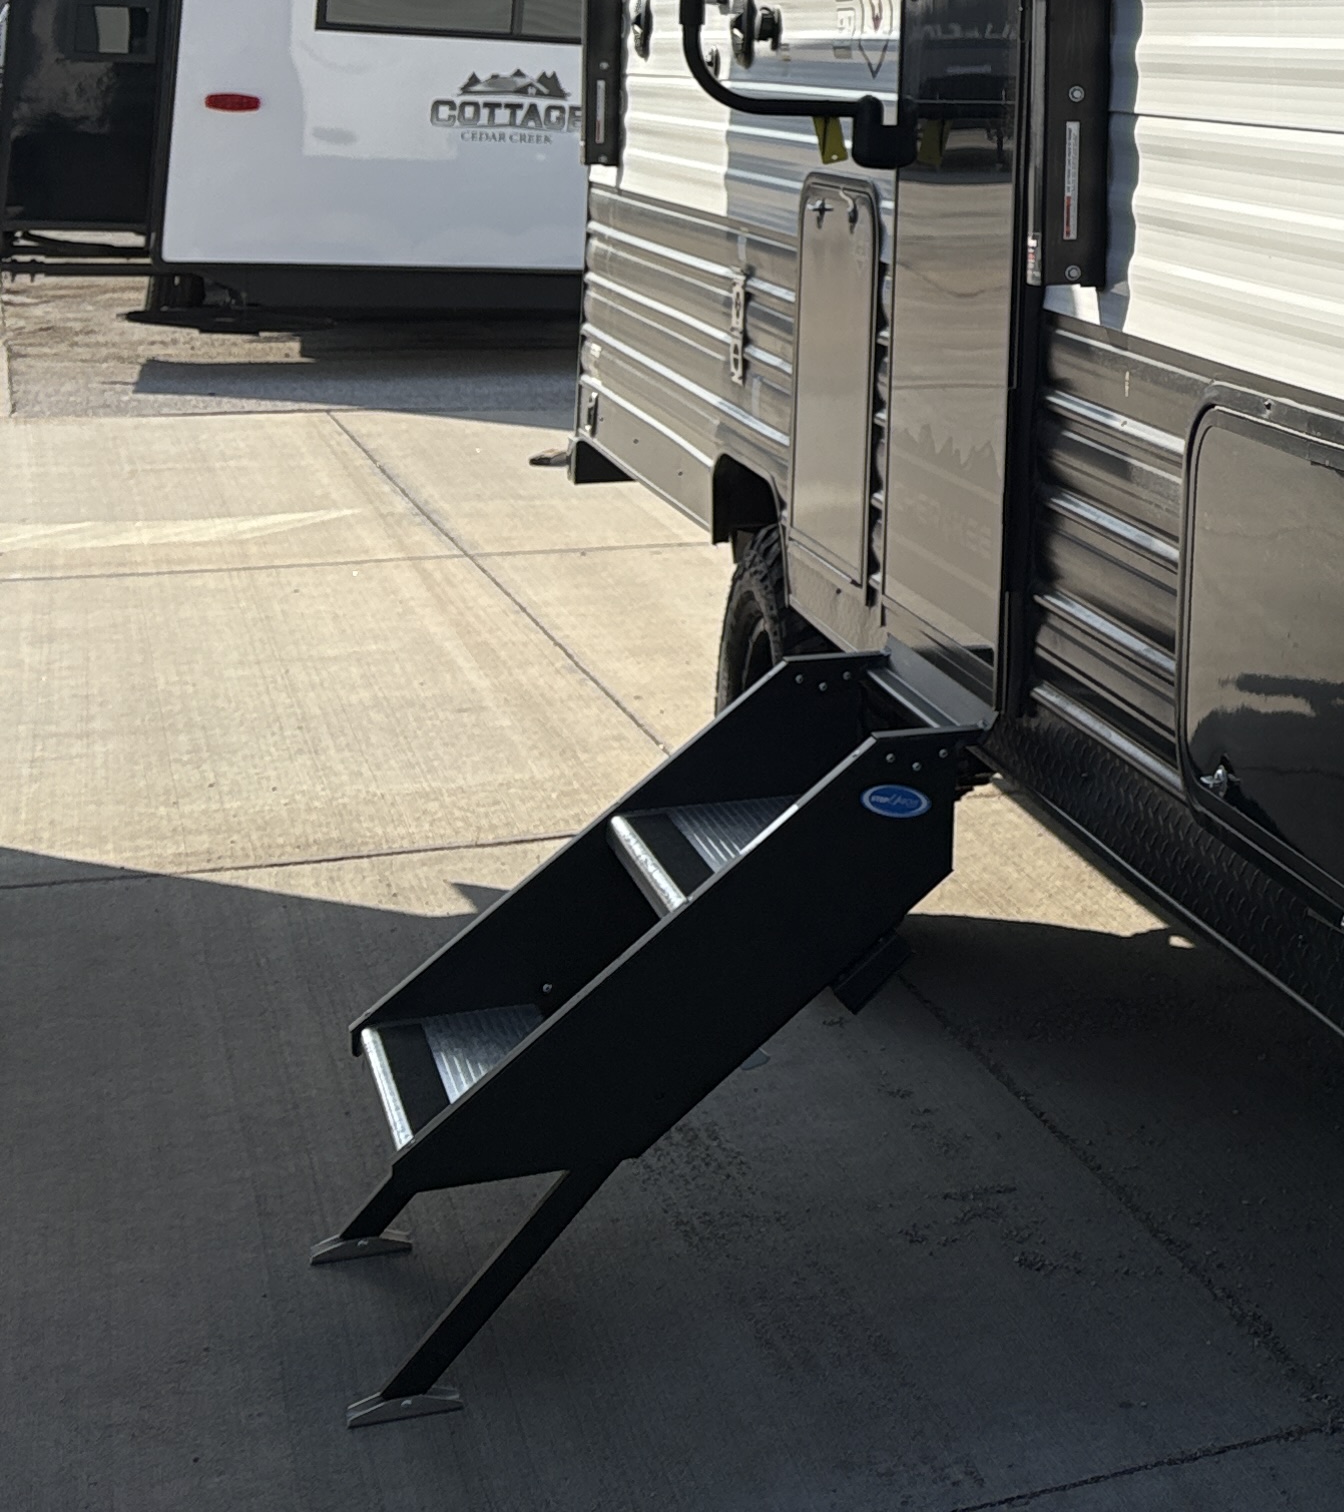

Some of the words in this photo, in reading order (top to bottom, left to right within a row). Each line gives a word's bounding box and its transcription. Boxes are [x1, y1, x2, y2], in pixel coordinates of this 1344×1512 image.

[430, 99, 582, 132] COTTAGE
[460, 131, 506, 143] CEDAR
[509, 132, 553, 144] CREEK
